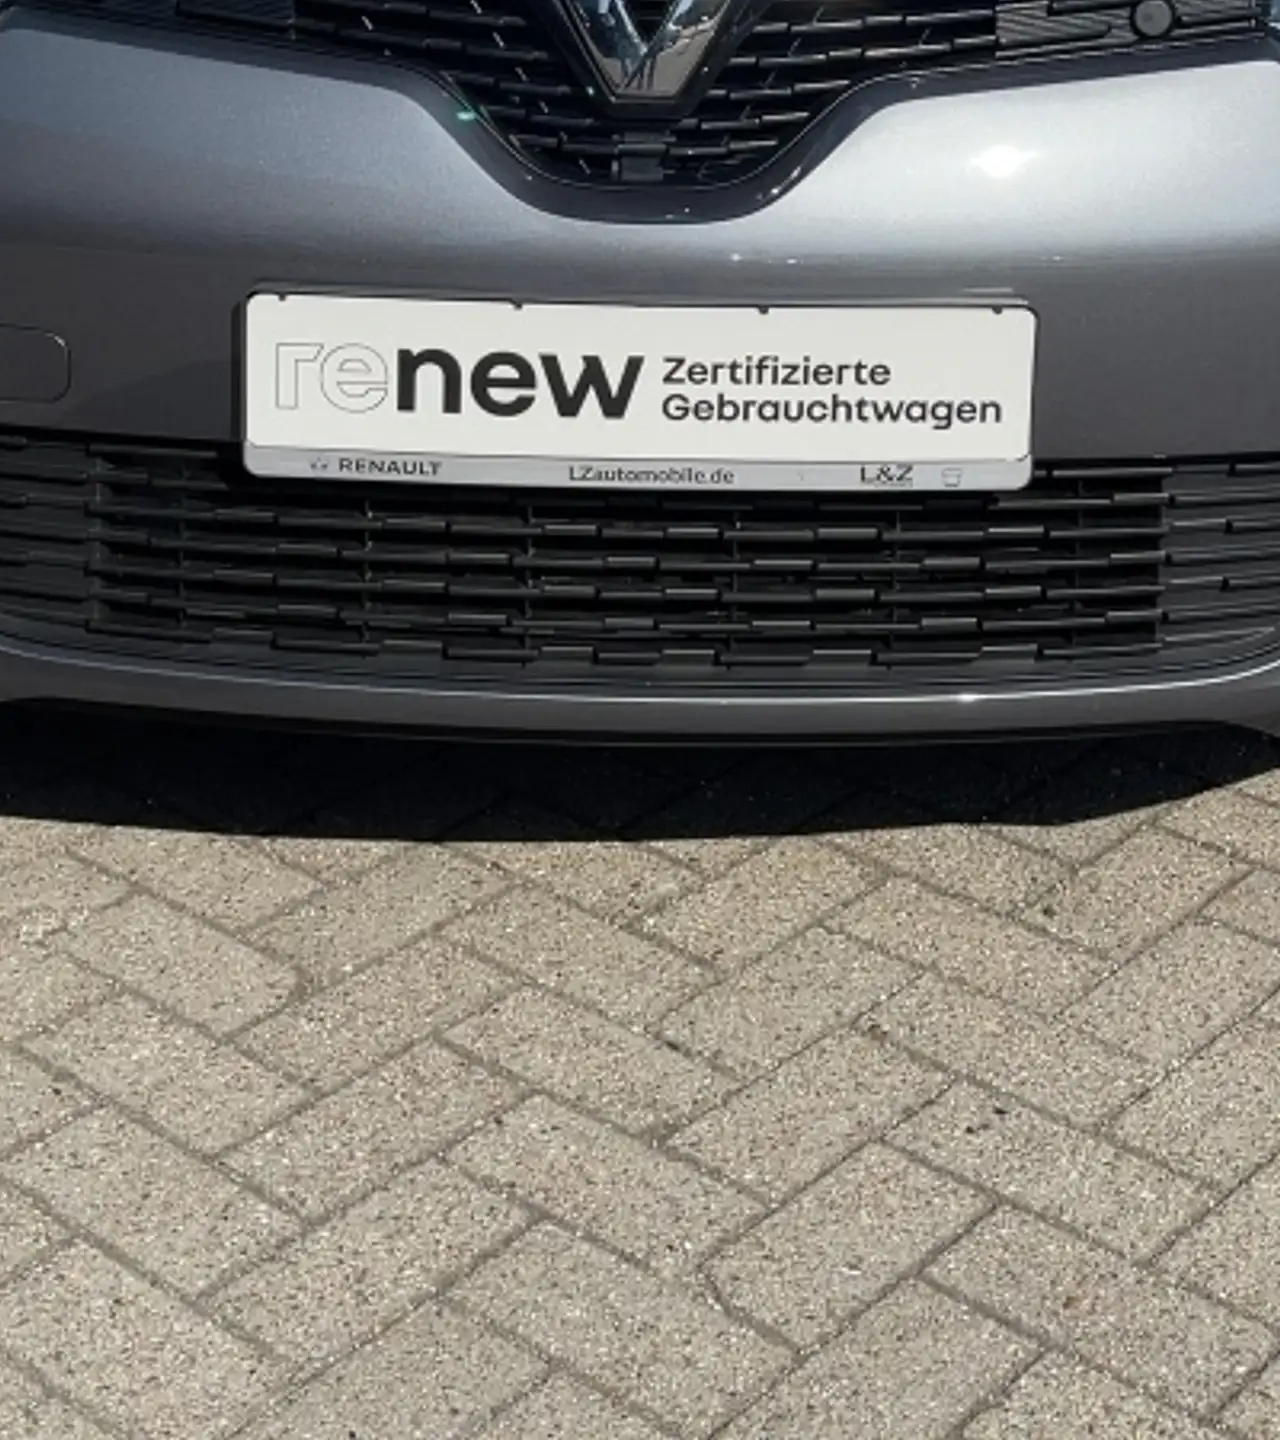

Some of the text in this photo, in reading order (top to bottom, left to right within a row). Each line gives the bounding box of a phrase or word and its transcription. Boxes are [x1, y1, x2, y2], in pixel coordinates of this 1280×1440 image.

[274, 341, 644, 419] renew
[662, 356, 891, 387] Zertifizierte
[661, 392, 1003, 430] Gebrauchtwagen
[338, 458, 442, 478] RENAULT
[568, 465, 735, 487] LZautomobile.de
[859, 463, 914, 483] L&Z
